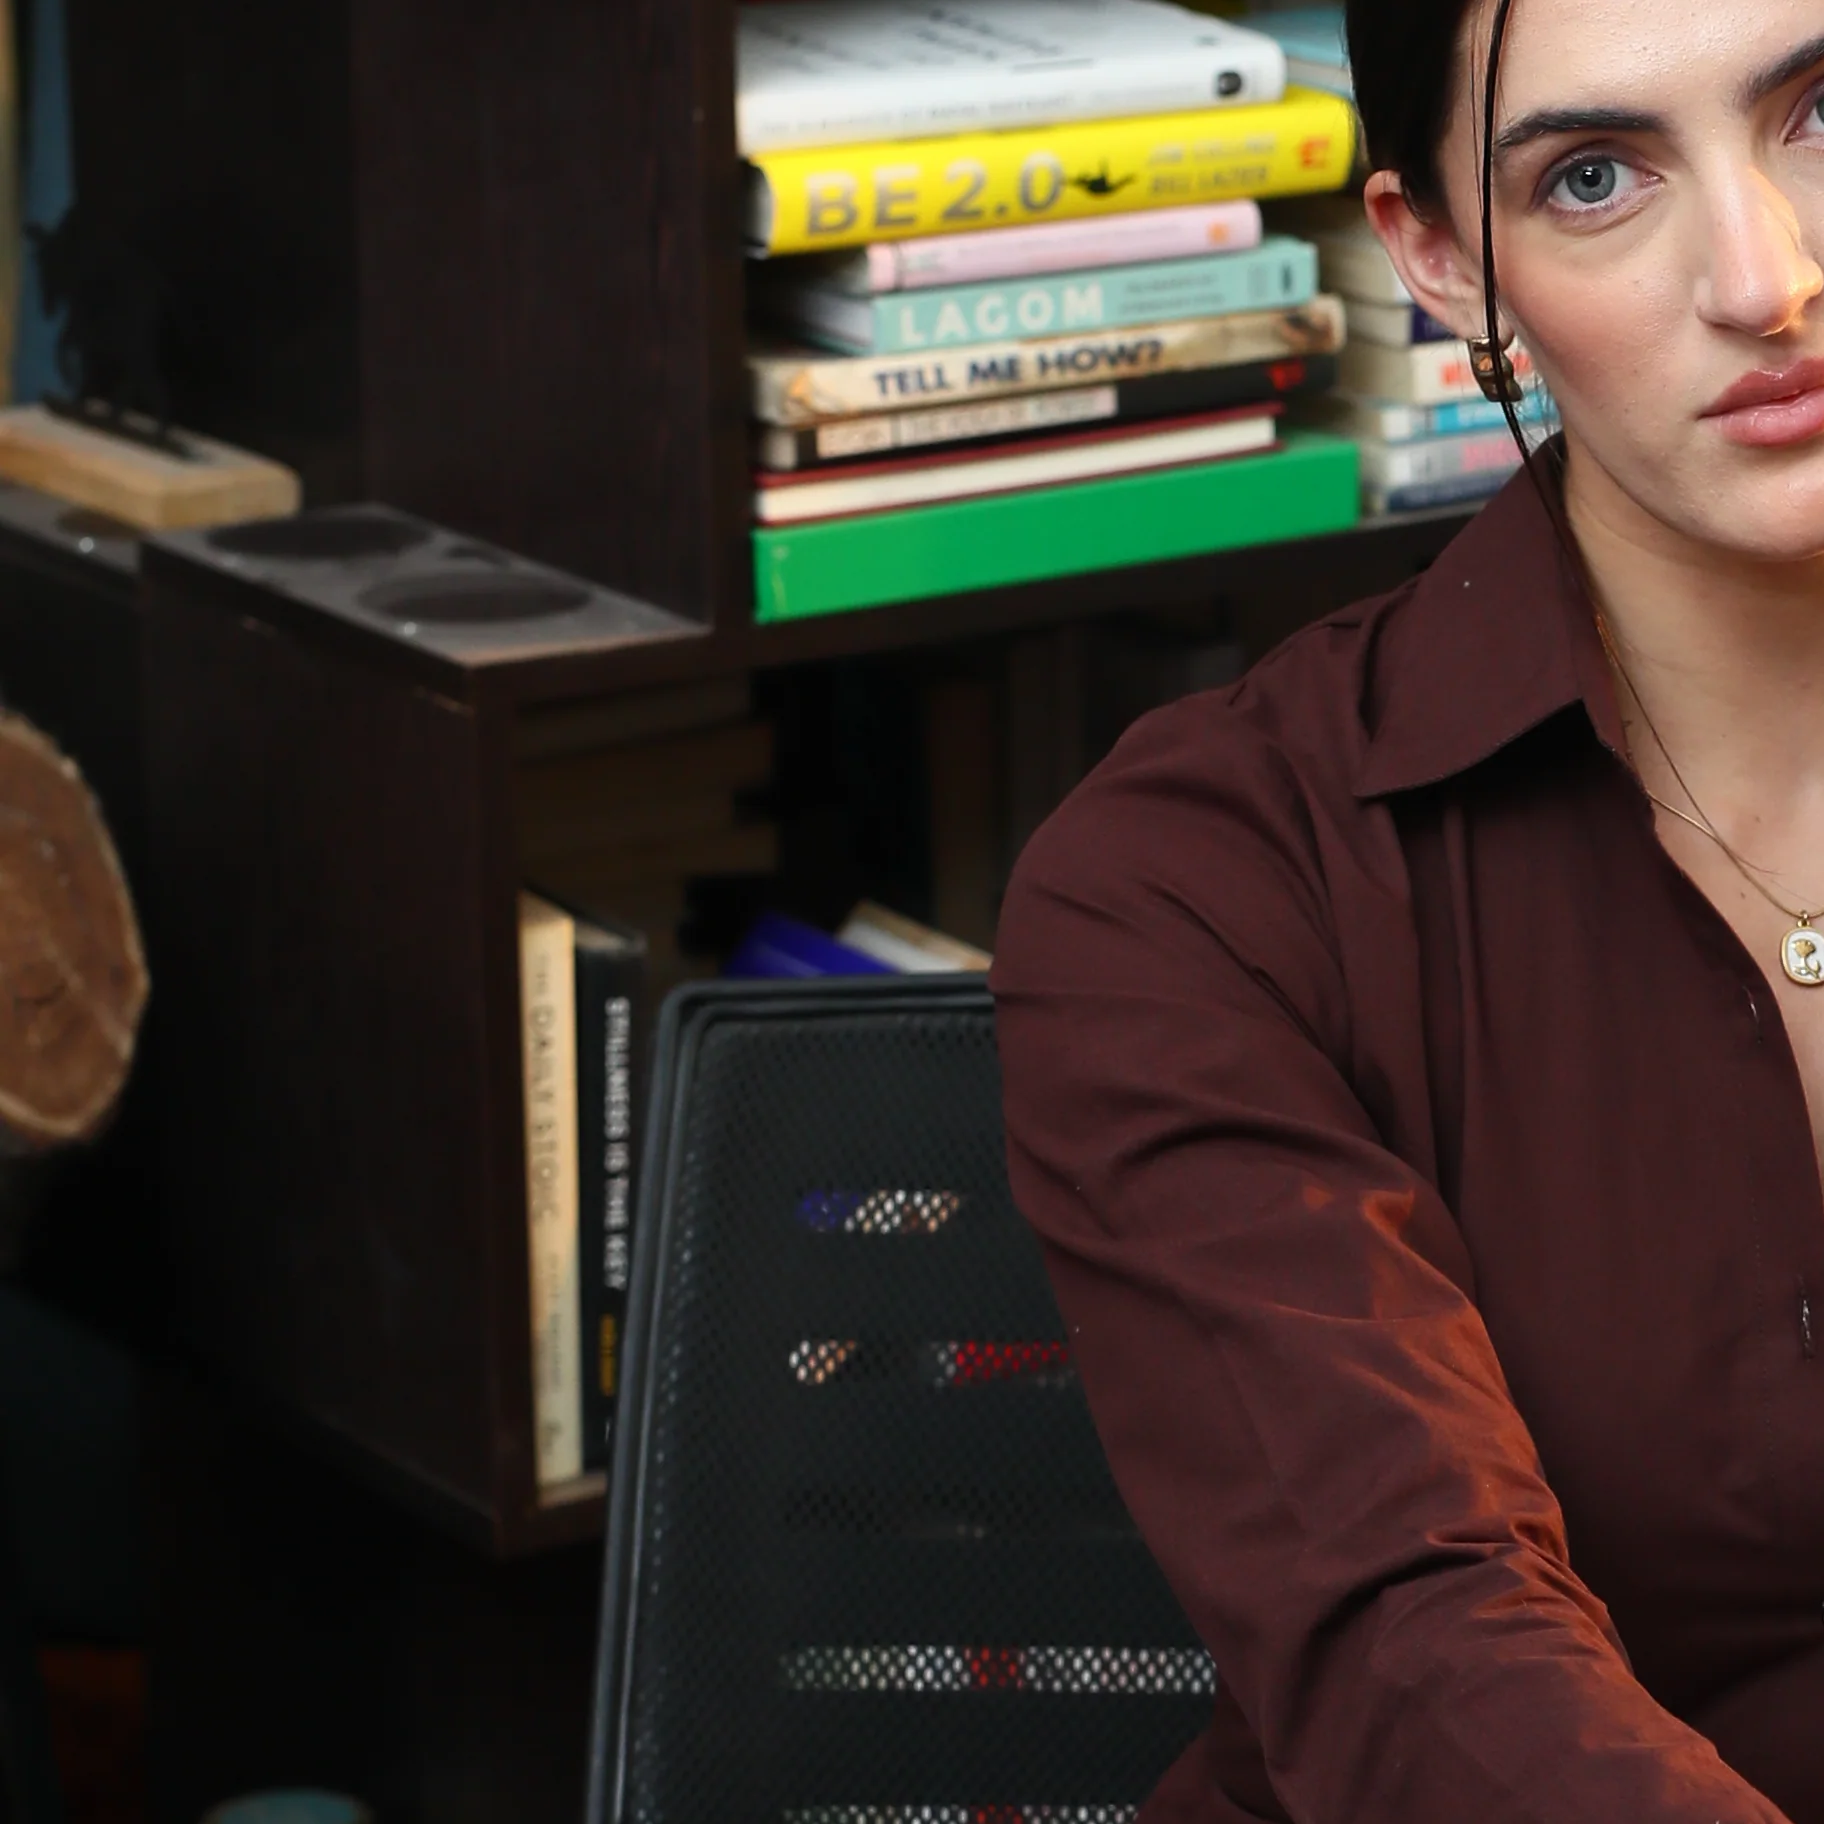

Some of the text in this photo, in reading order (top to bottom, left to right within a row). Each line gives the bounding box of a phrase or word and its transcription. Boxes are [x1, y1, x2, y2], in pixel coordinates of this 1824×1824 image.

[804, 150, 1066, 235] BE 2.0
[899, 281, 1105, 347] LAGOM
[874, 338, 1167, 397] TELL ME HOW?
[602, 996, 631, 1139] STILLNESS
[602, 1141, 628, 1172] IS
[602, 1175, 627, 1231] THE
